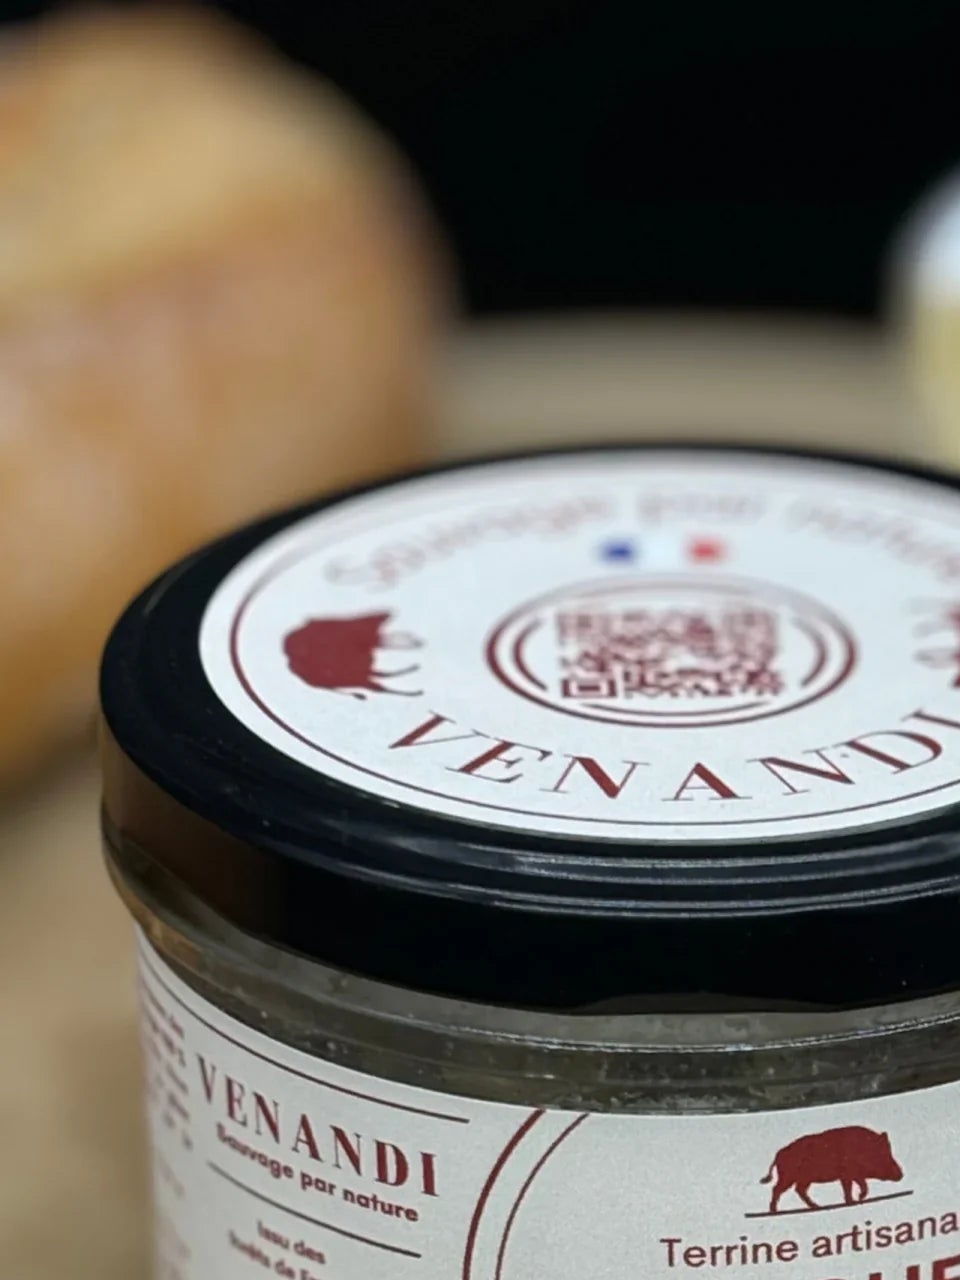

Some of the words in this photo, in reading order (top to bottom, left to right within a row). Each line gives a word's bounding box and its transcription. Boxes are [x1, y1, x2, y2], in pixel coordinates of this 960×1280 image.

[197, 1053, 440, 1197] VENANDI
[300, 1171, 336, 1195] par
[342, 1186, 419, 1222] nature
[293, 1240, 326, 1265] des
[660, 1238, 798, 1268] Terrine
[274, 1259, 296, 1280] de
